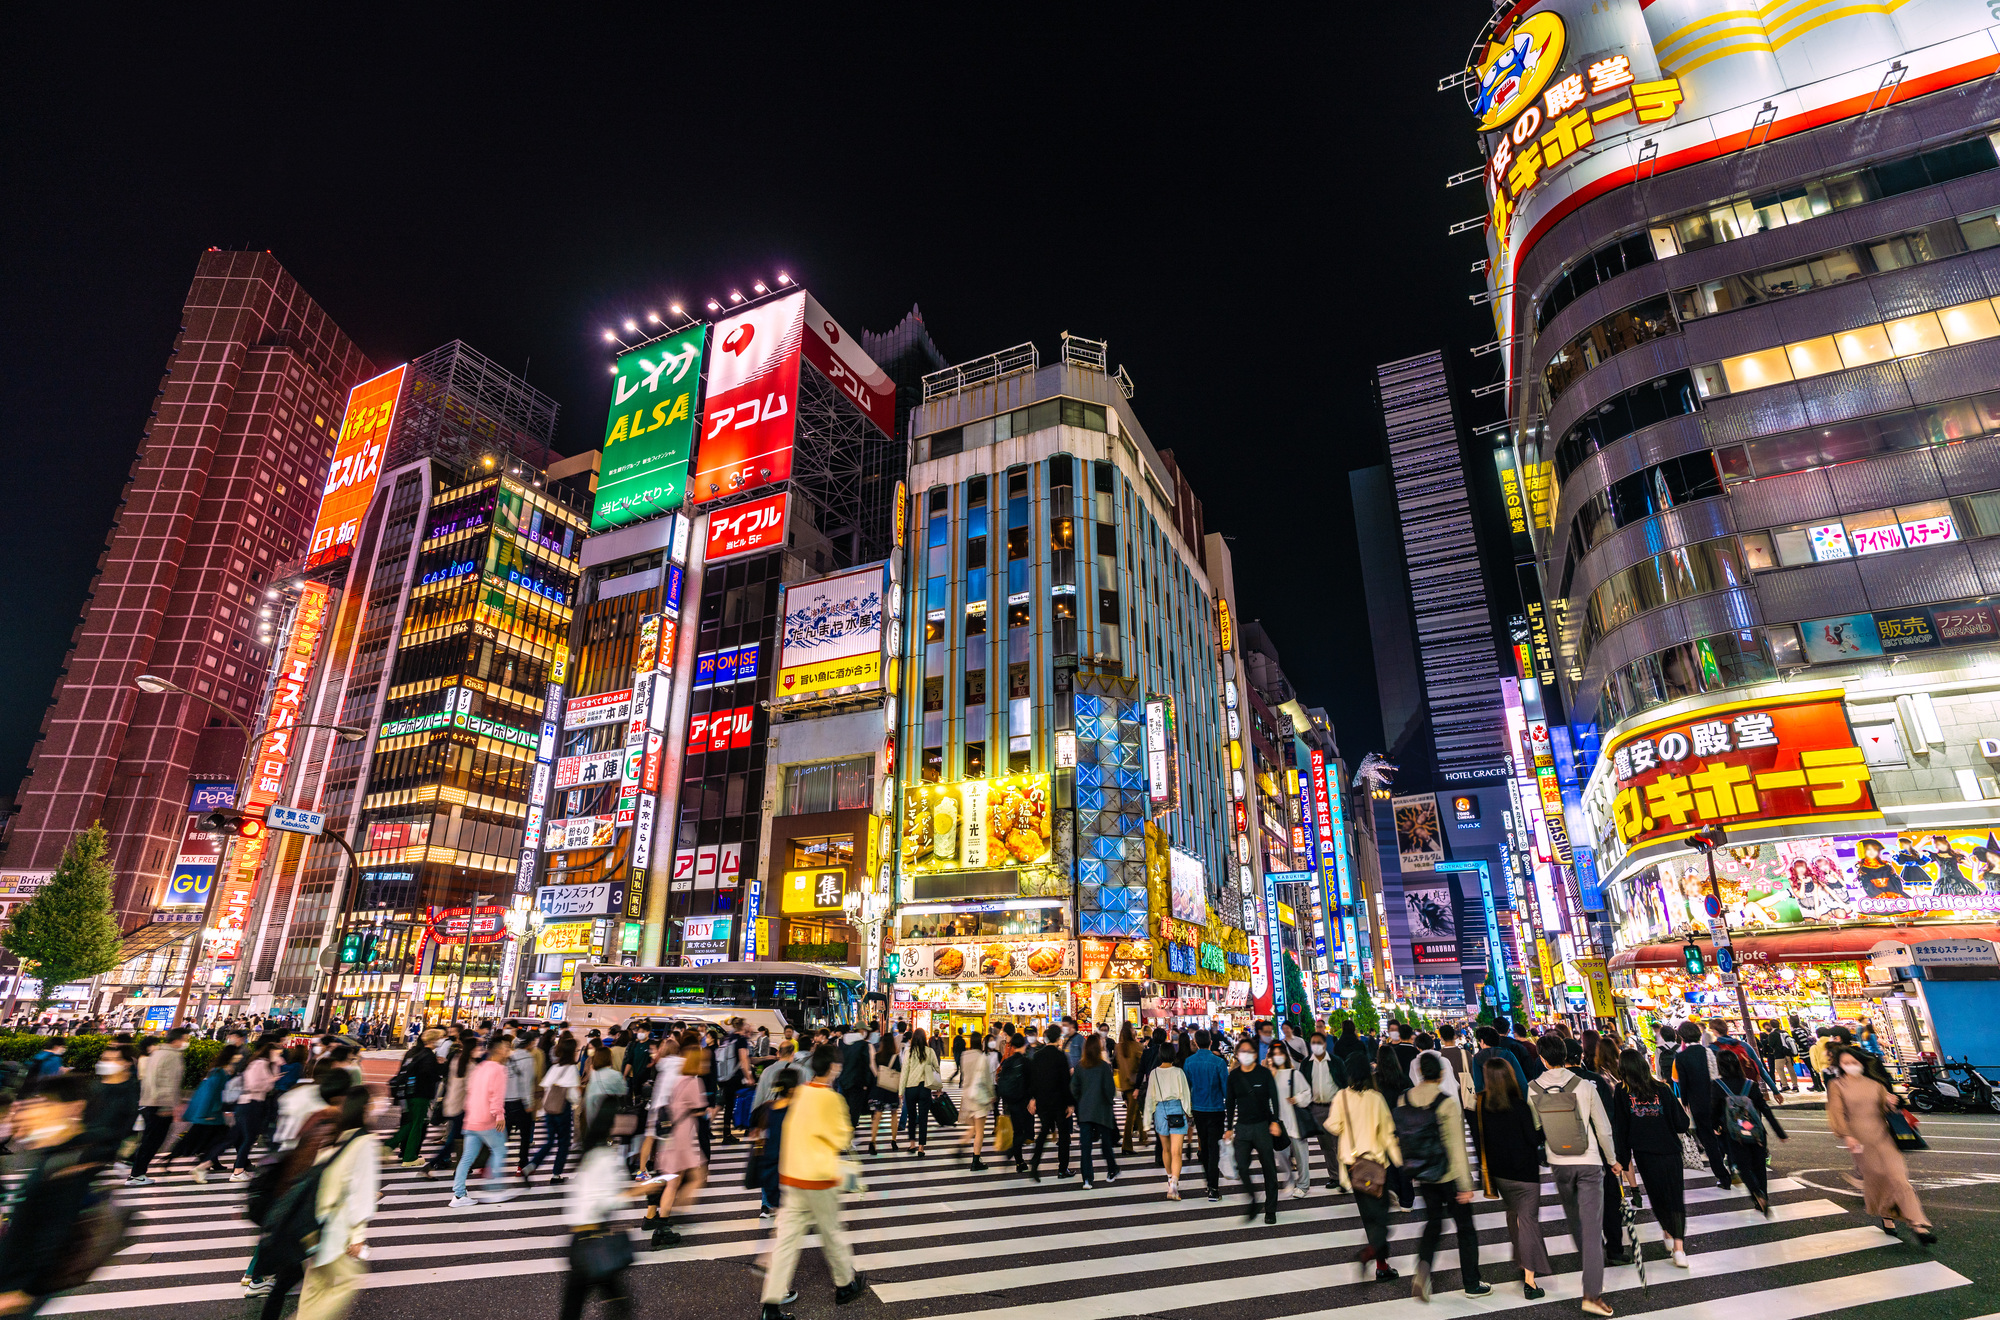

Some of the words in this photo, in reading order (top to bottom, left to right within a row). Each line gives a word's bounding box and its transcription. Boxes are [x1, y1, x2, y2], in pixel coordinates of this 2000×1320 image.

[829, 355, 871, 412] アコム
[337, 400, 393, 445] パチンコ
[606, 393, 689, 446] ALSA
[708, 392, 788, 439] アコム
[324, 440, 381, 495] エスパス
[729, 467, 753, 490] 3F
[601, 487, 661, 515] 当ビルとなり
[1502, 469, 1525, 533] 驚安の殿堂
[712, 506, 781, 541] アイフル
[531, 530, 560, 553] BAR
[726, 539, 746, 550] 当ビル
[748, 534, 762, 544] 5F
[1856, 529, 1900, 552] アイドル
[1906, 519, 1951, 544] ステージ
[422, 561, 474, 584] CASINO
[510, 571, 564, 604] POKER
[671, 570, 679, 600] PROMISE
[297, 593, 325, 656] パチンコ
[793, 614, 873, 641] だんまや水産
[1878, 617, 1929, 638] 販売
[1938, 612, 1988, 628] ブランド
[1943, 624, 1990, 637] BRAND
[662, 630, 672, 664] アイフル
[1528, 603, 1555, 685] ドン・キホーテ
[700, 651, 756, 673] PROMISE
[801, 662, 877, 685] 旨い魚に酒が合う！
[269, 659, 307, 756] エスパス
[447, 689, 455, 709] ダーツ
[461, 690, 470, 710] ダーツ
[634, 681, 647, 715] 専門店
[606, 704, 628, 719] 本陣
[692, 713, 752, 740] アイフル
[715, 740, 725, 748] 5F
[1614, 713, 1779, 781] 驚安の殿堂
[647, 756, 656, 781] アコム
[1063, 754, 1072, 764] 光
[259, 759, 283, 792] 日拓
[583, 759, 618, 781] 本陣
[1474, 768, 1507, 778] GRACER
[197, 792, 235, 804] PePe
[1313, 754, 1331, 837] カラオケ歌広場
[1542, 777, 1559, 802] 麻雀
[274, 808, 320, 825] 歌舞伎町
[281, 820, 310, 830] Kabukicho
[620, 812, 634, 821] AT
[189, 833, 214, 841] 無印良
[568, 826, 590, 837] 粉もの
[908, 796, 919, 865] レモンサワー
[970, 824, 979, 836] 光
[567, 836, 589, 847] 専門店
[236, 829, 264, 882] チンコ
[675, 851, 739, 879] アコム
[969, 855, 979, 865] 4F
[1402, 855, 1441, 863] アムステルダム
[1705, 857, 1788, 875] ハロウィン
[174, 874, 213, 893] GU
[634, 872, 643, 888] 買取
[816, 875, 841, 905] 集
[1736, 876, 1772, 893] 革命
[556, 886, 604, 899] メンズライフ
[1914, 894, 2000, 911] Hallowee
[554, 902, 593, 913] クリニック
[630, 897, 639, 912] 販売
[557, 928, 577, 938] やきとり
[688, 924, 712, 937] BUY
[556, 938, 577, 948] センター
[1267, 892, 1278, 955] GODZILLA
[1274, 961, 1282, 992] ROAD
[1427, 945, 1455, 953] MARUHAN
[1916, 945, 1989, 955] 安全安心ステーション
[1251, 939, 1260, 974] トラノコ
[1736, 951, 1767, 962] ijote
[900, 968, 925, 977] らそば
[1008, 1002, 1046, 1013] とらそば
